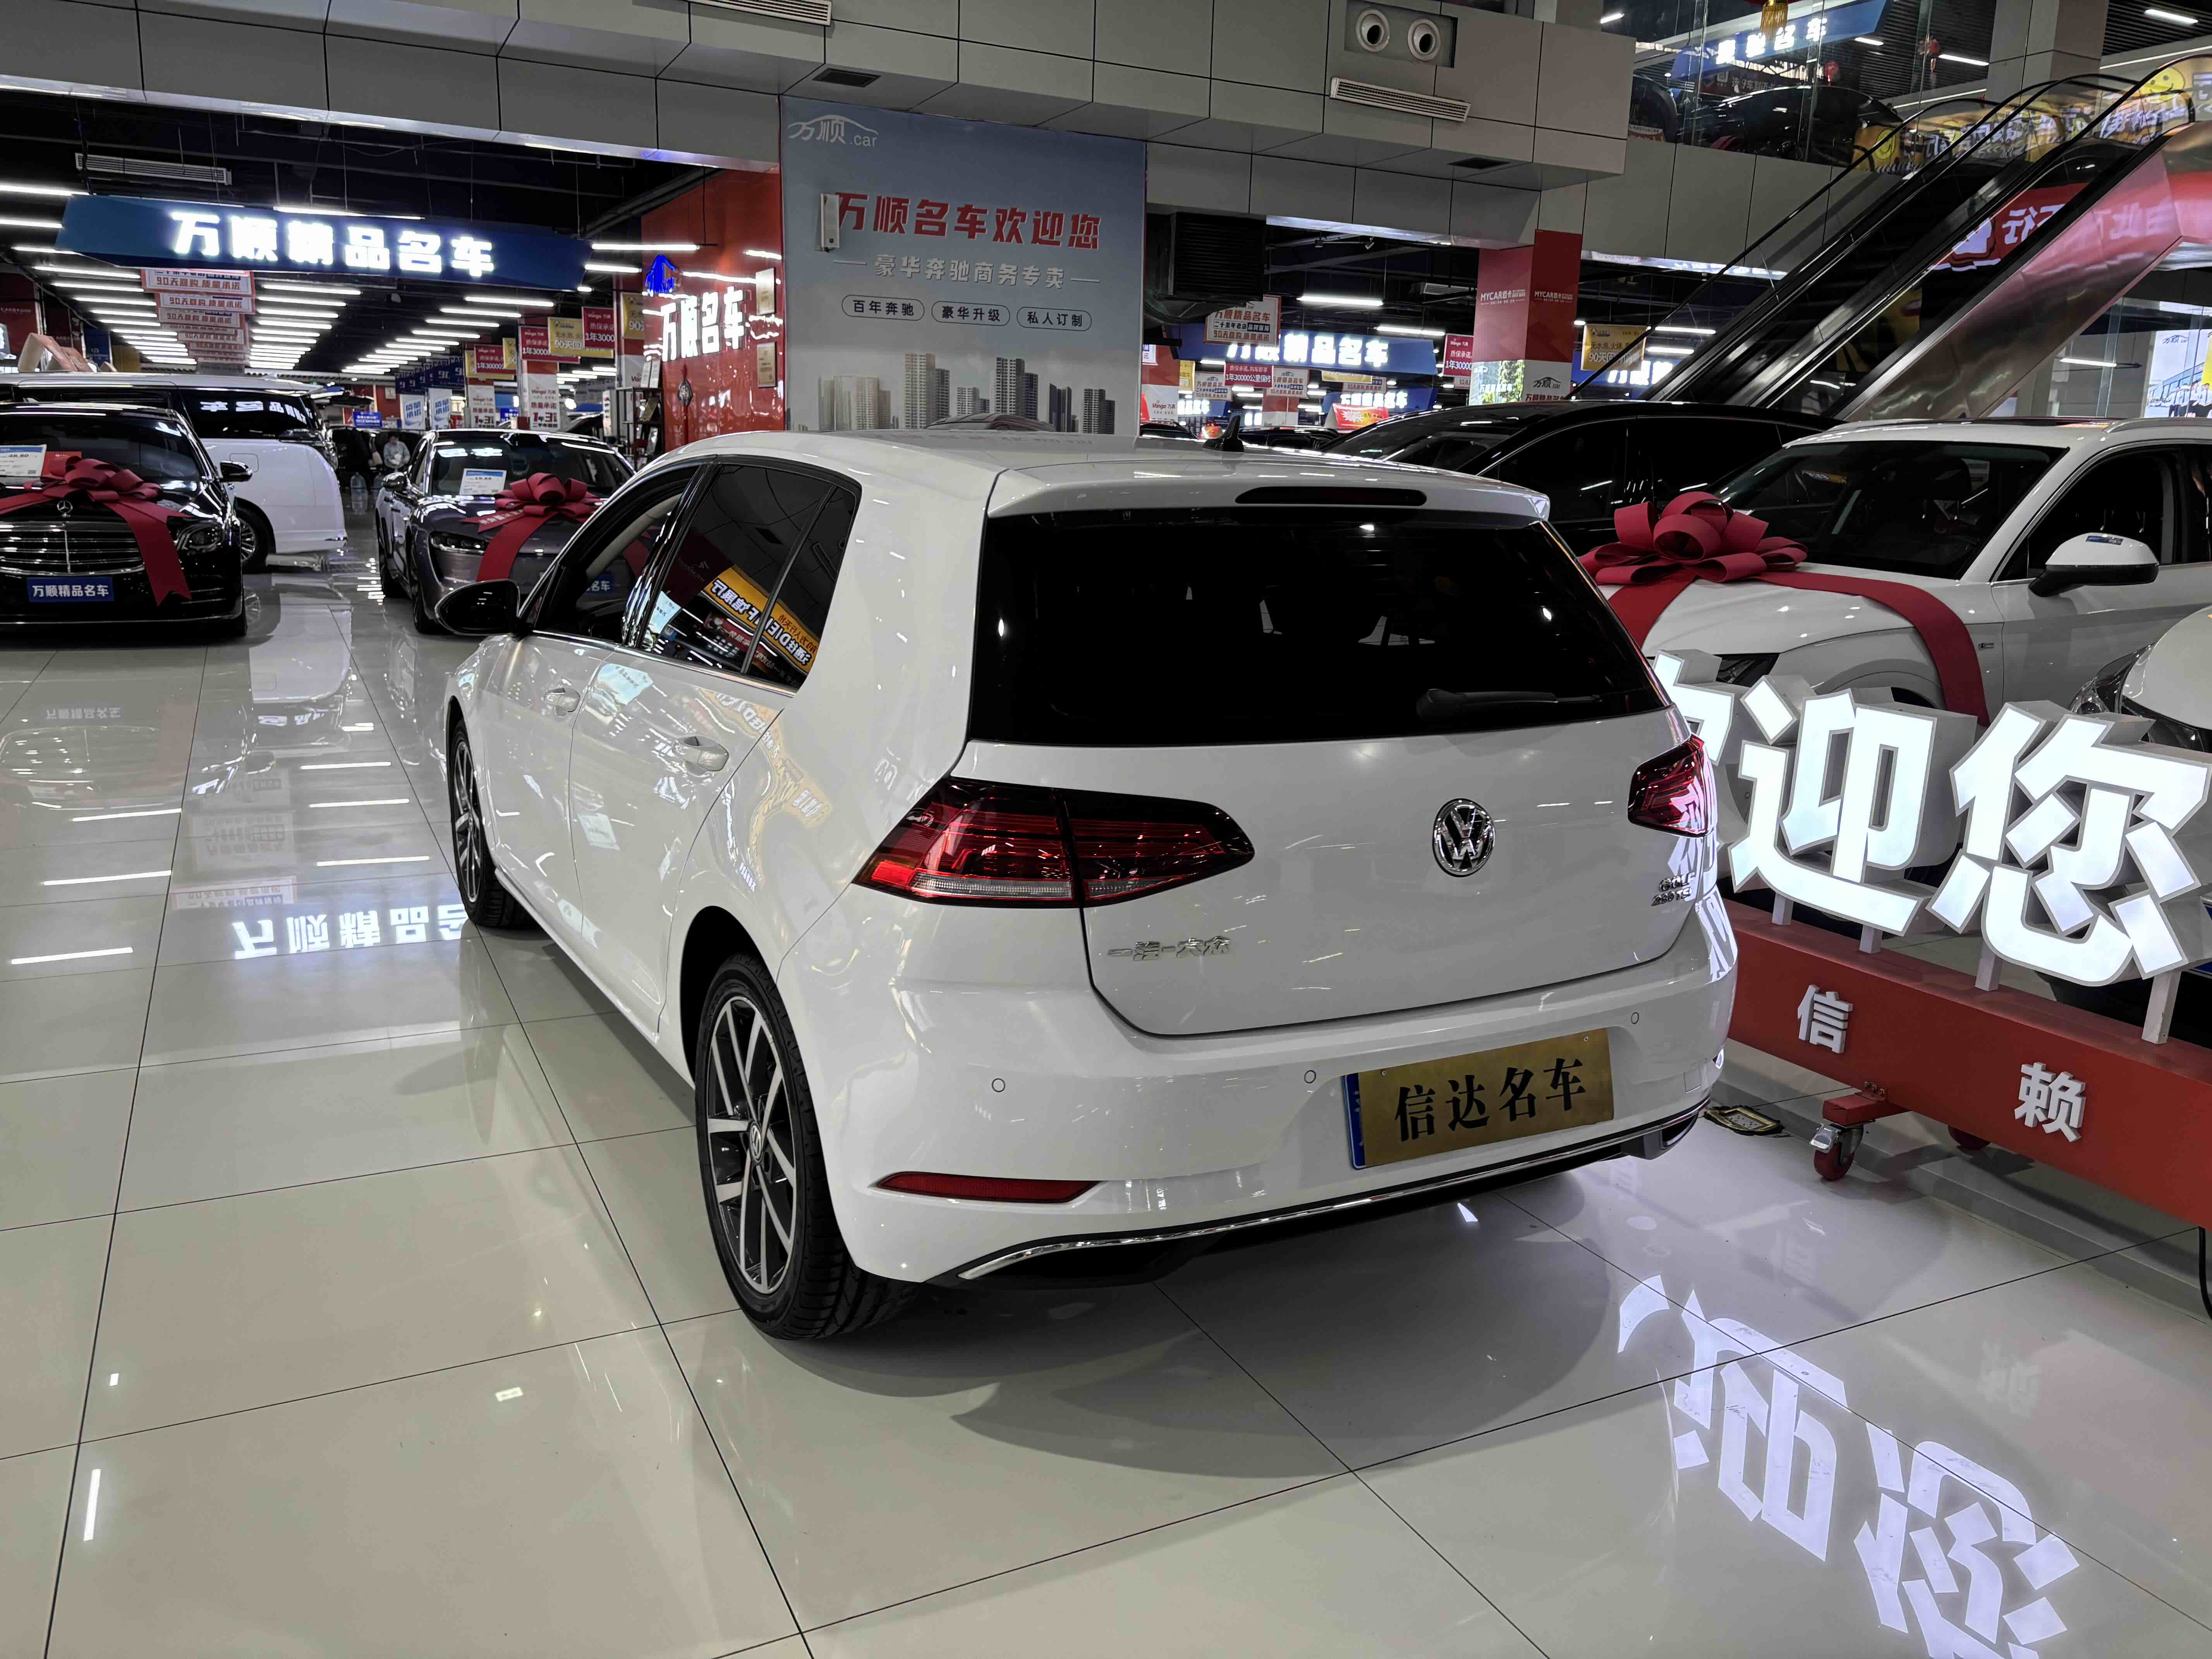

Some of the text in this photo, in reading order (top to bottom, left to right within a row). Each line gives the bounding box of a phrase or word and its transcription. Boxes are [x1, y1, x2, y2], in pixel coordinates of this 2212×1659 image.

[836, 191, 1102, 250] 万顺名车欢迎您
[170, 211, 495, 277] 万顺精品名车
[874, 253, 1065, 290] 豪华奔驰商务专卖
[853, 300, 914, 317] 百年奔驰
[941, 306, 1001, 322] 豪华升级
[1027, 311, 1083, 328] 私人订制
[32, 584, 109, 597] 万顺精品名车
[586, 580, 611, 591] 名车
[1653, 649, 2210, 986] 迎您
[1659, 871, 1695, 892] GOLF
[1797, 984, 2086, 1142] 信 赖
[1395, 1058, 1586, 1142] 信达名车
